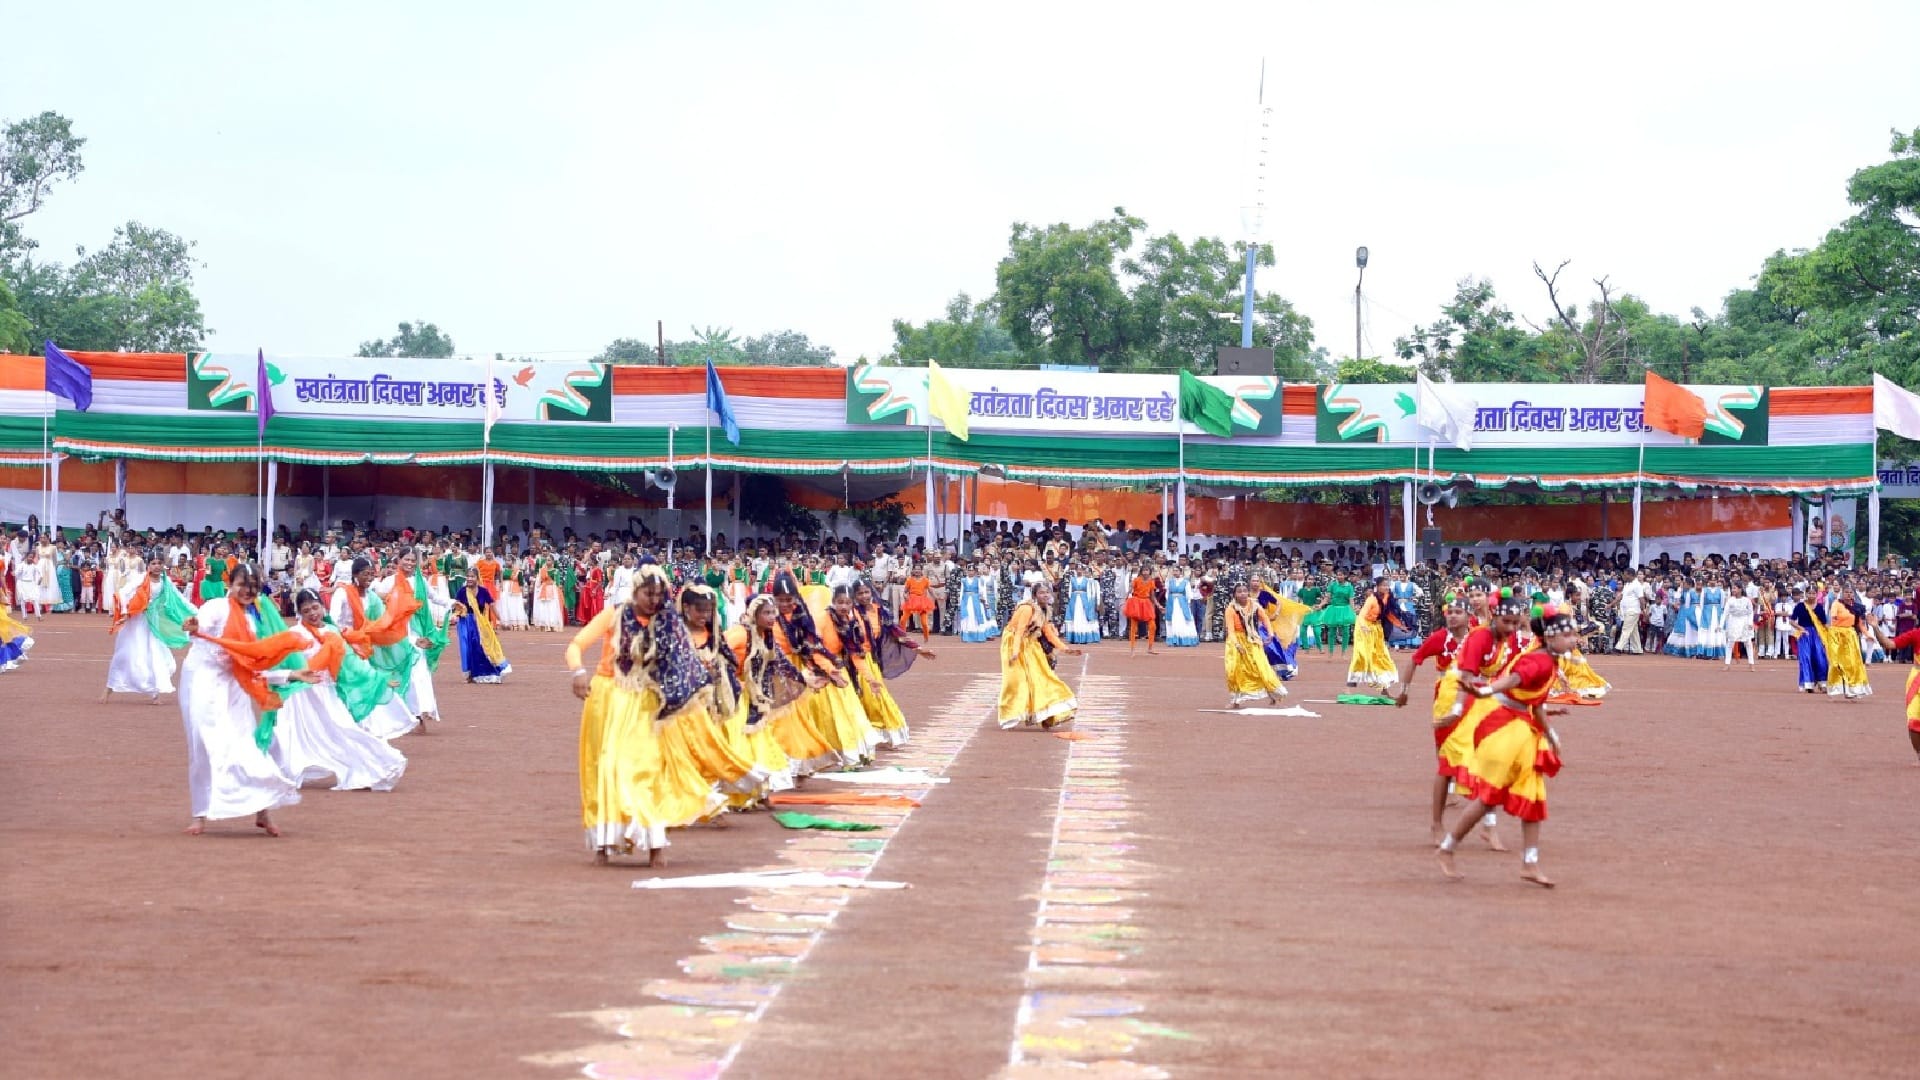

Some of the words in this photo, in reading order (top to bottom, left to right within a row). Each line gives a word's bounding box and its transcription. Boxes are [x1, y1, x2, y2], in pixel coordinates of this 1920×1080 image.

[371, 374, 424, 405] दिवस
[426, 382, 478, 407] अमर
[968, 385, 1033, 418] वतंत्रता
[1035, 386, 1088, 419] दिवस
[1090, 394, 1143, 421] अमर
[1144, 390, 1177, 422] रहे
[1508, 400, 1568, 432] दिवस
[1569, 406, 1621, 432] अमर
